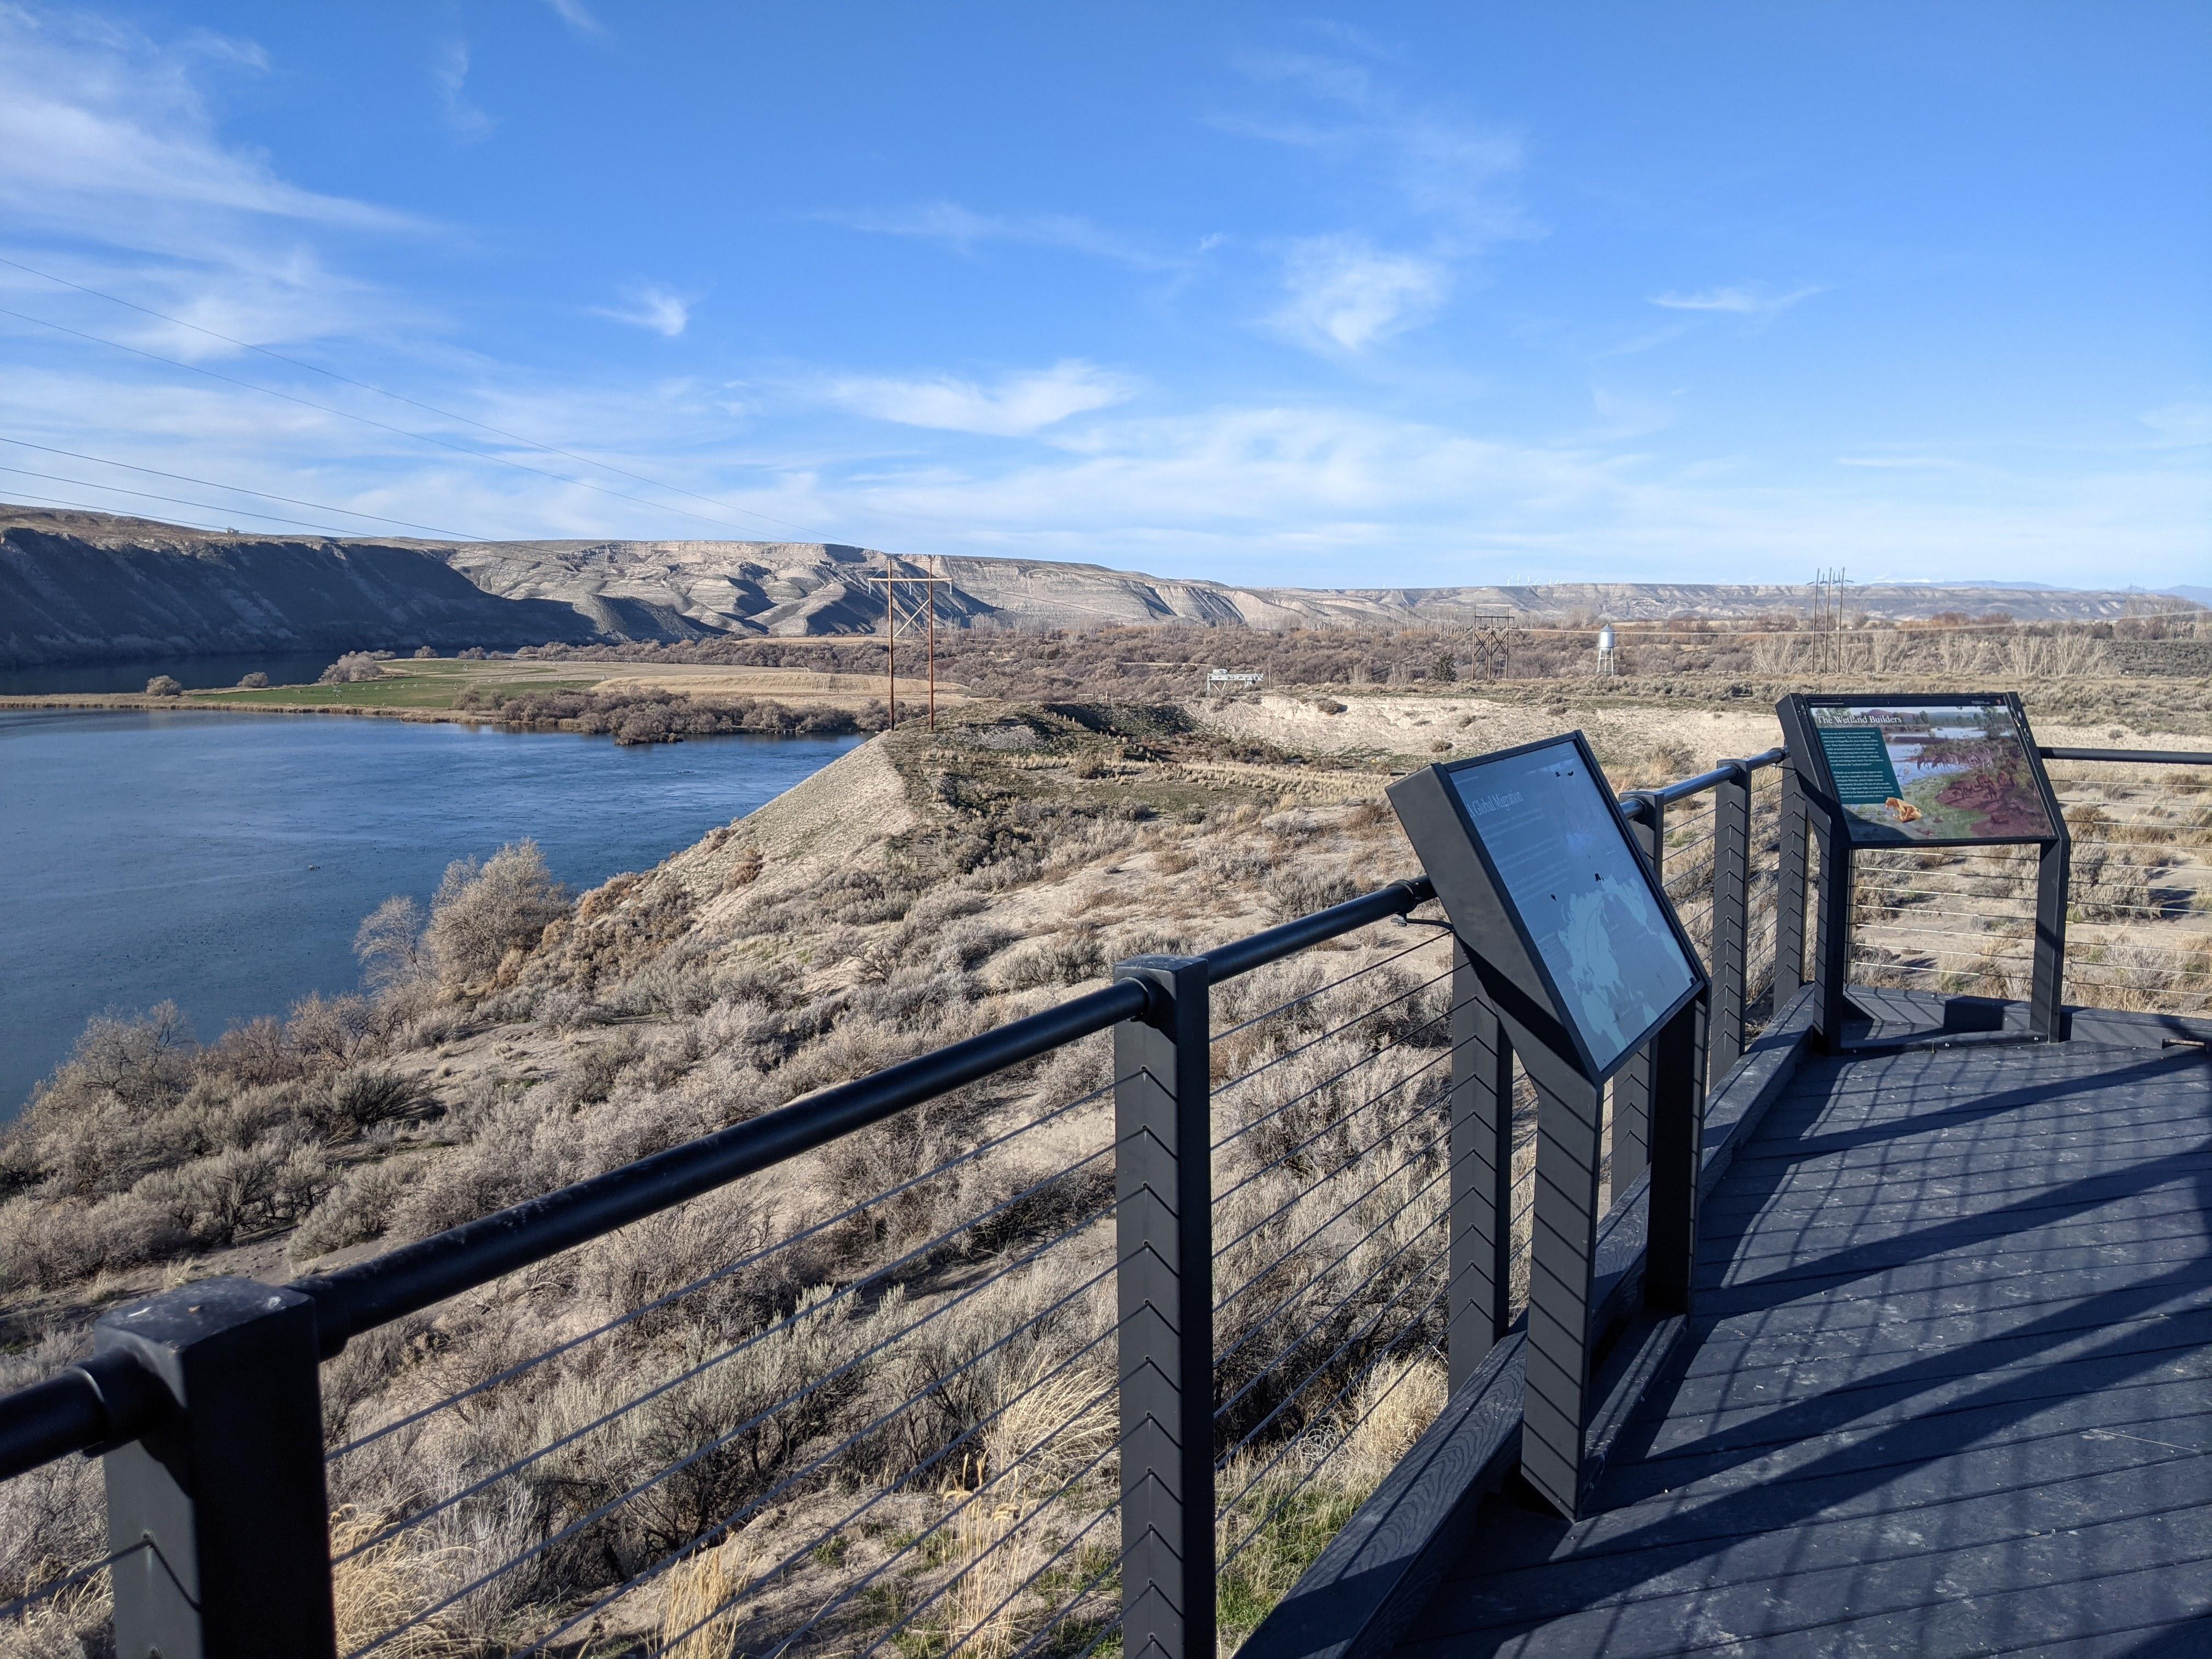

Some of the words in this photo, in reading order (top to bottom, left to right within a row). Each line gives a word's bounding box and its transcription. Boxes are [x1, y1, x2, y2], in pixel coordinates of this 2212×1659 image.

[1816, 715, 1833, 724] The
[1834, 715, 1868, 724] Wetland
[1869, 715, 1902, 723] Builders
[1472, 796, 1496, 815] Global
[1492, 790, 1523, 811] Migration
